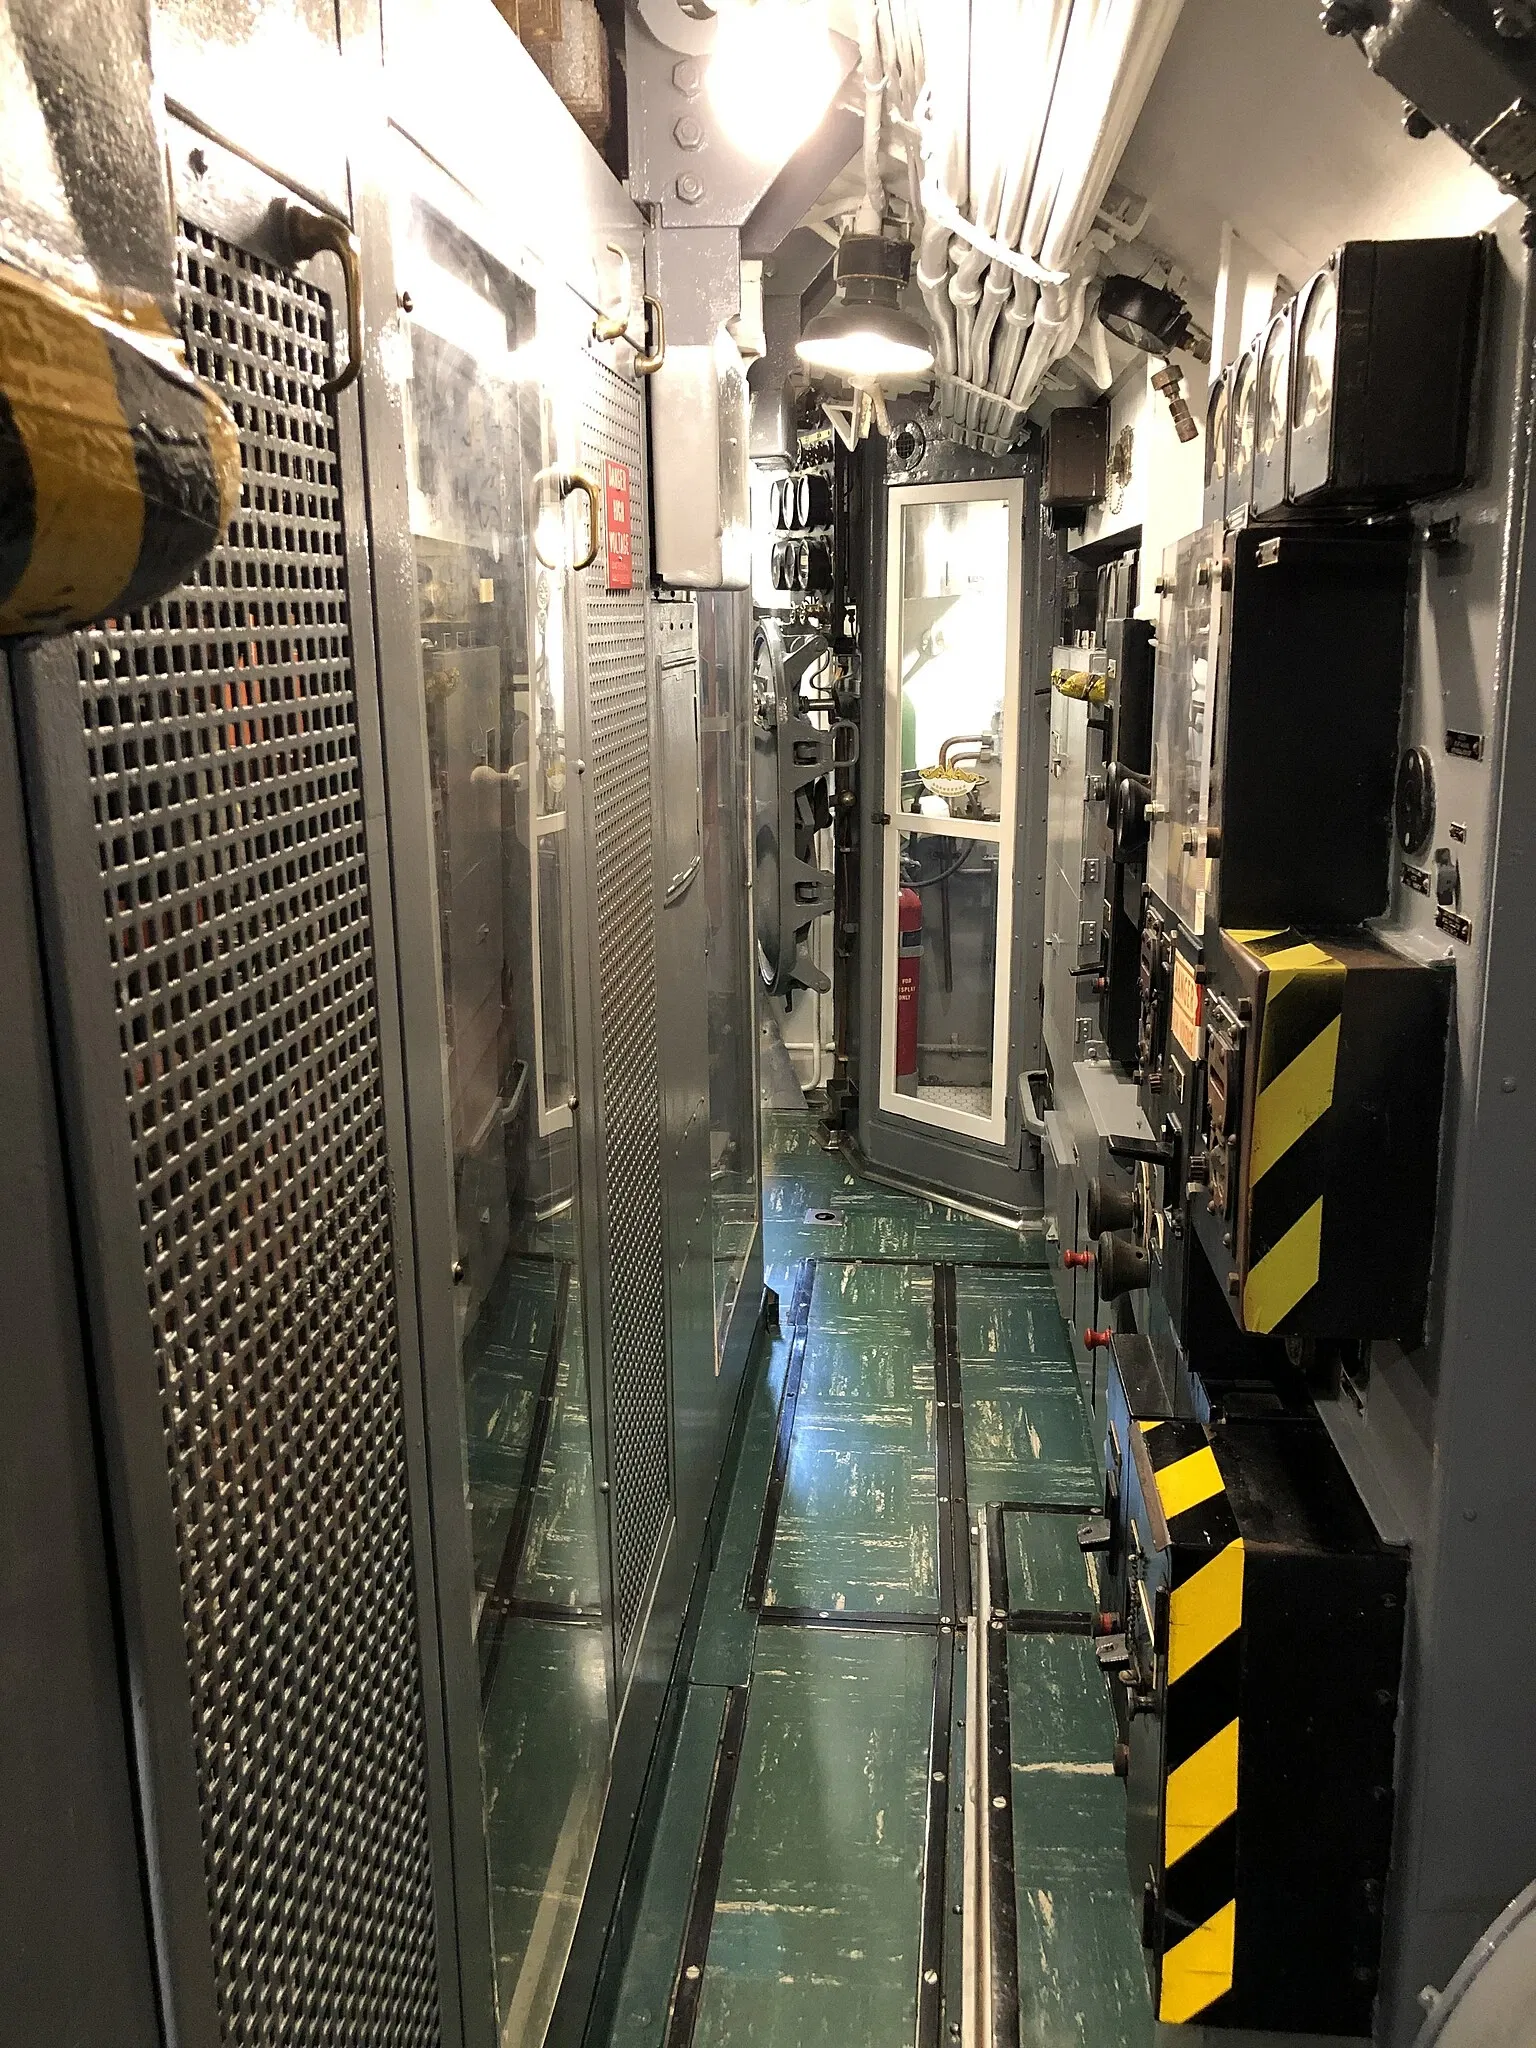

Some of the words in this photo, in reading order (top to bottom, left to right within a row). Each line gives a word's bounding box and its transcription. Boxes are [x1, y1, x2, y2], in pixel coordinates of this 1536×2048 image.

[608, 464, 627, 492] DANGER
[613, 499, 625, 523] HIGH
[609, 531, 630, 556] VOLTAGE
[1174, 963, 1195, 1014] DANGER
